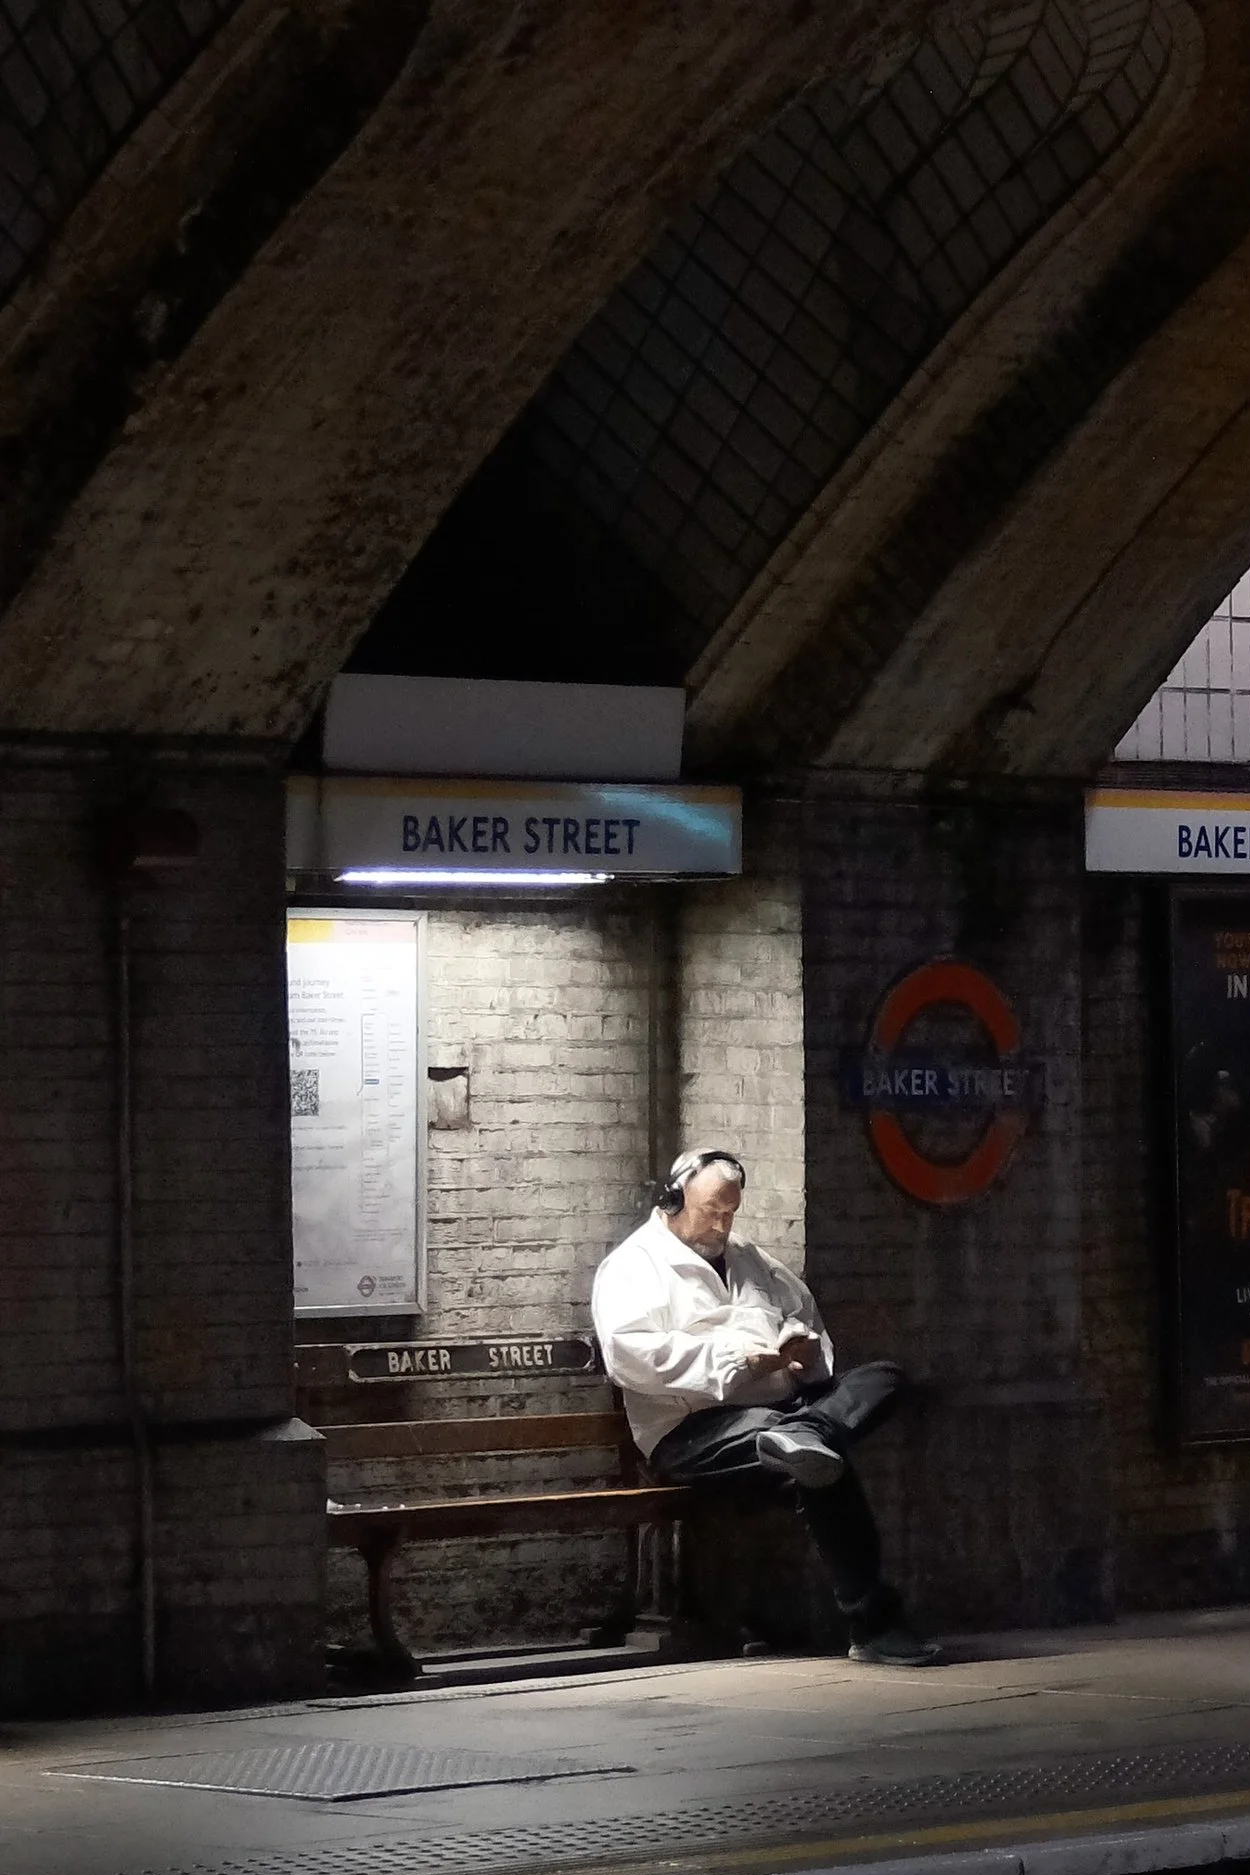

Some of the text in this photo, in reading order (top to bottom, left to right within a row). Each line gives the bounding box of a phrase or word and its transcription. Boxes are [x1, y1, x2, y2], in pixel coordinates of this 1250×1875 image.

[402, 815, 641, 855] BAKER STREET
[1226, 974, 1249, 999] IN
[862, 1068, 940, 1097] BAKER
[387, 1344, 553, 1374] BAKER STREET
